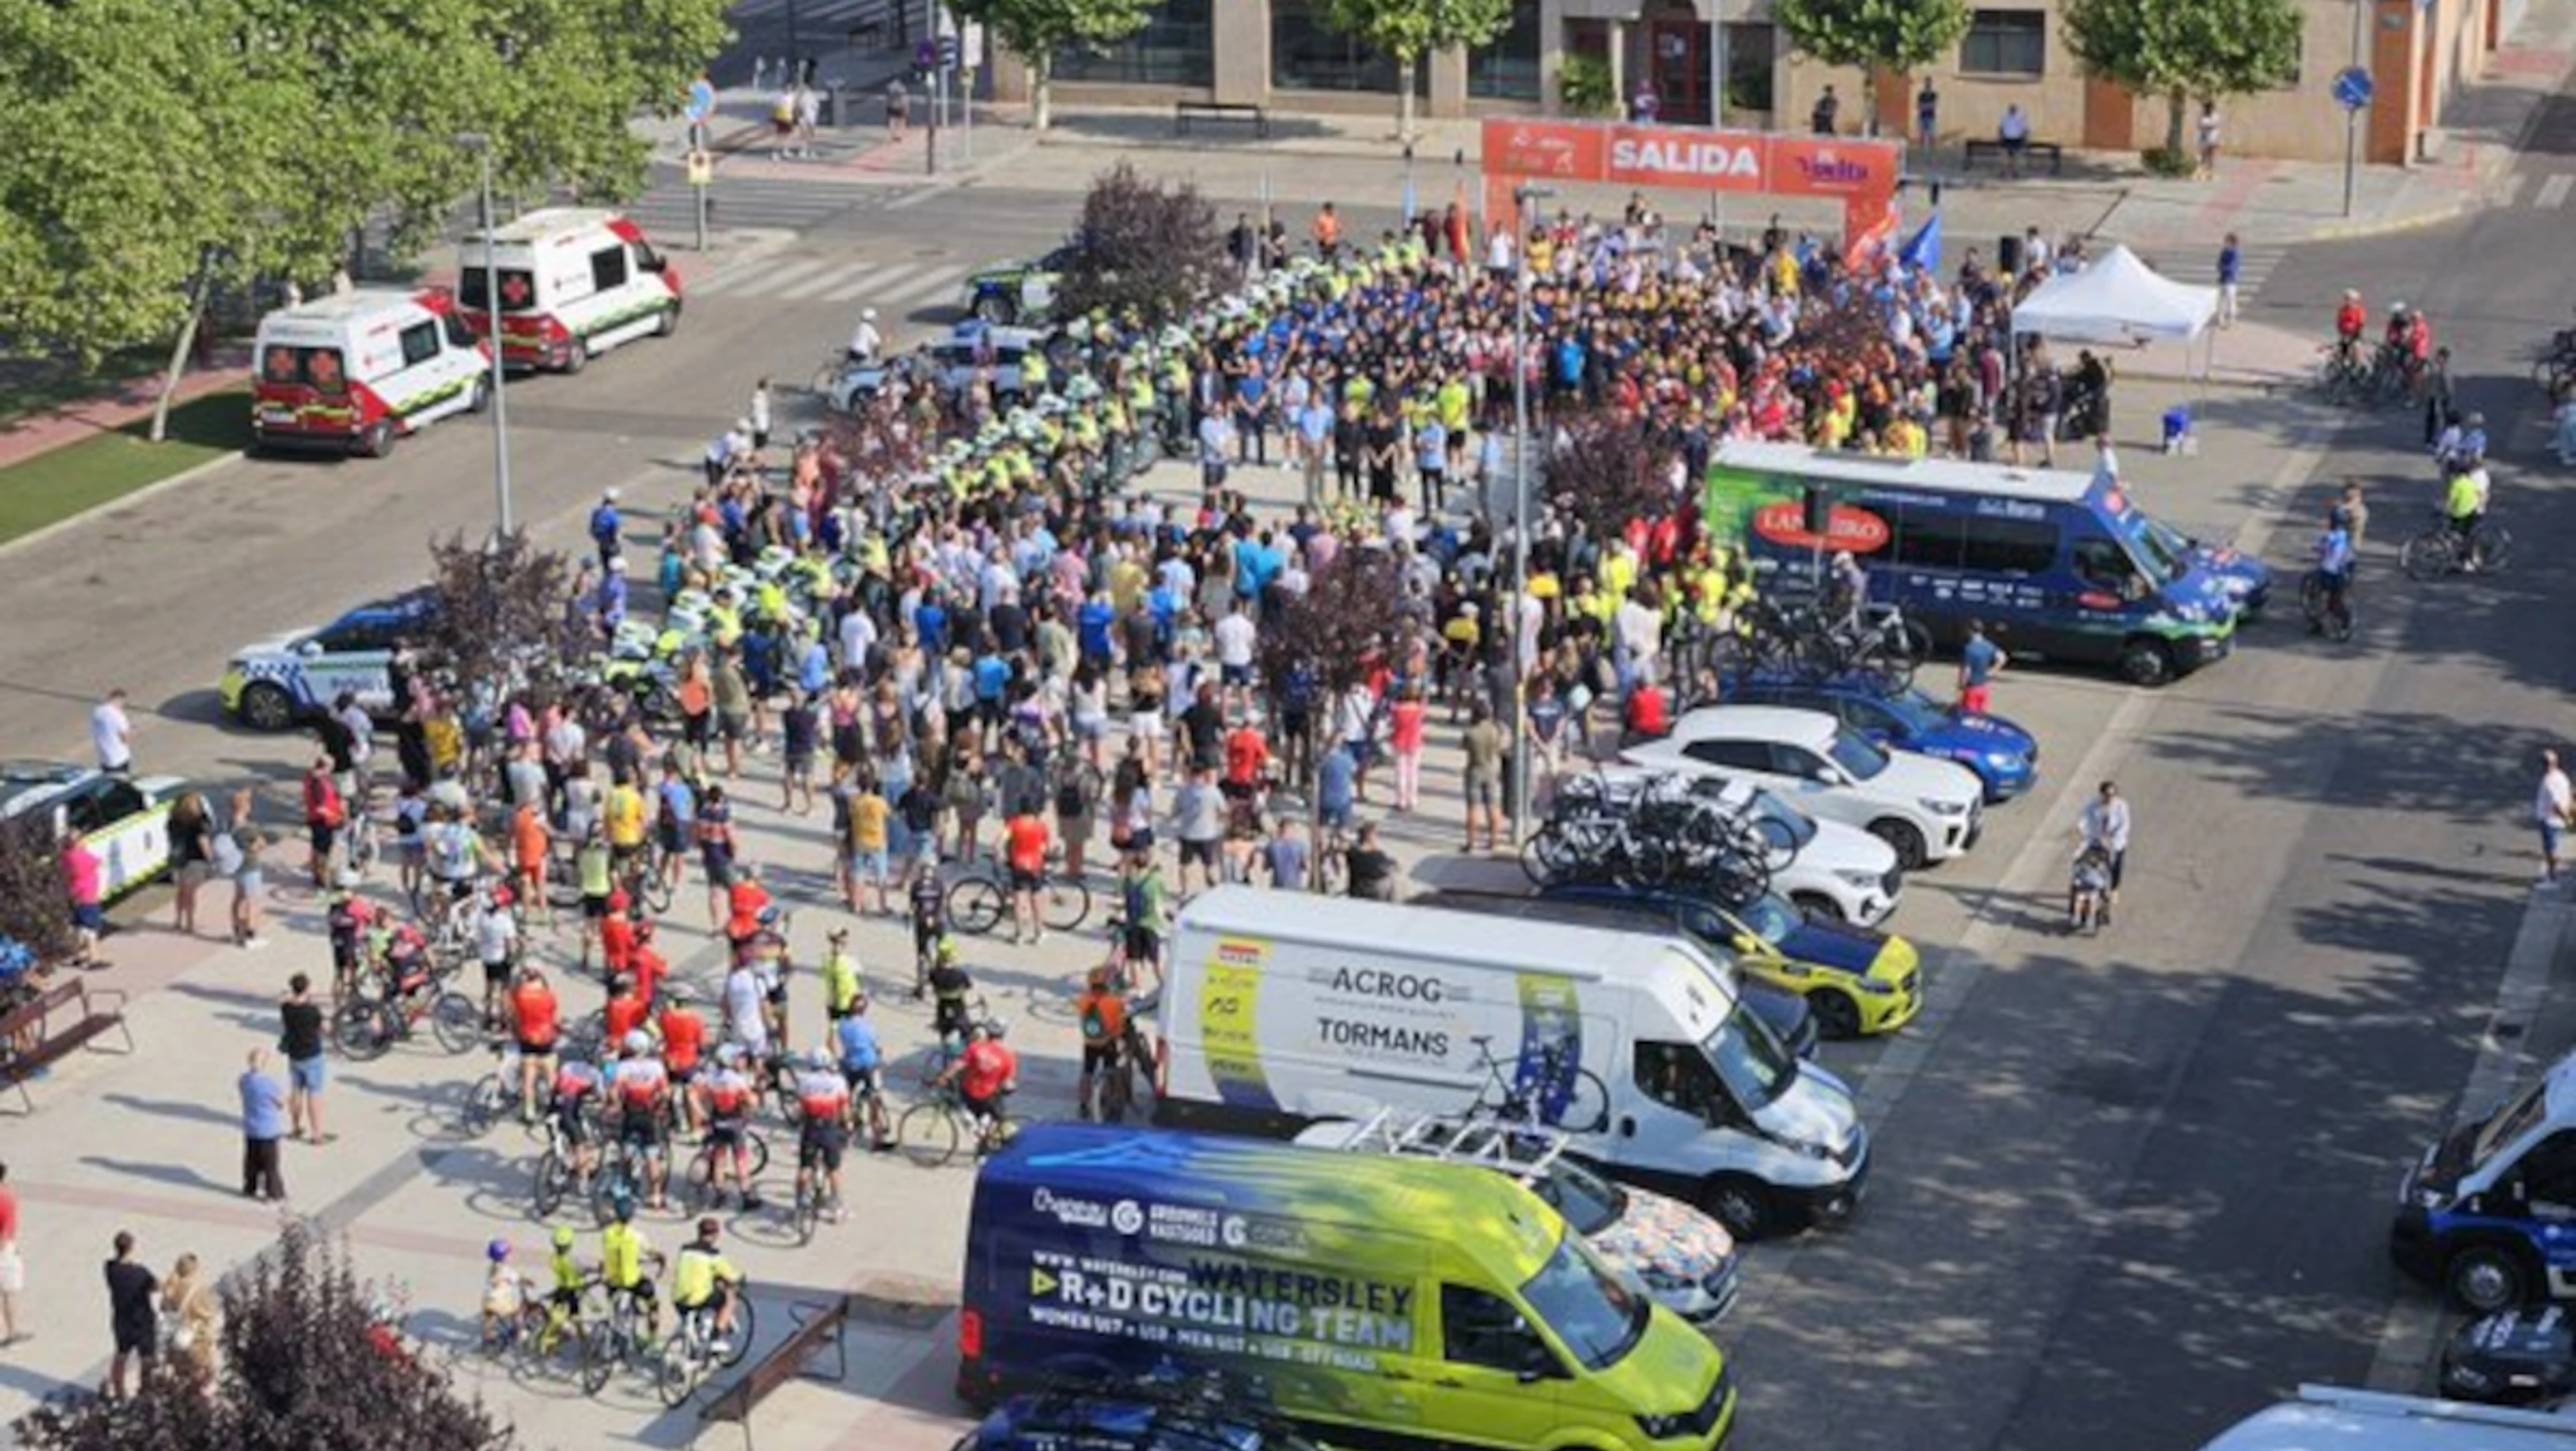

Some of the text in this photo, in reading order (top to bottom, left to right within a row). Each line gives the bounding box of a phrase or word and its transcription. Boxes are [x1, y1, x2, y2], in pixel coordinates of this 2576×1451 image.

[1612, 139, 1760, 176] SALIDA
[1332, 967, 1442, 1003] ACROG
[1317, 1017, 1448, 1057] TORMANS
[1189, 1256, 1413, 1315] WATERSLEY
[1029, 1305, 1091, 1329] WOMEN
[1059, 1269, 1409, 1351] R+D CYCLING TEAM
